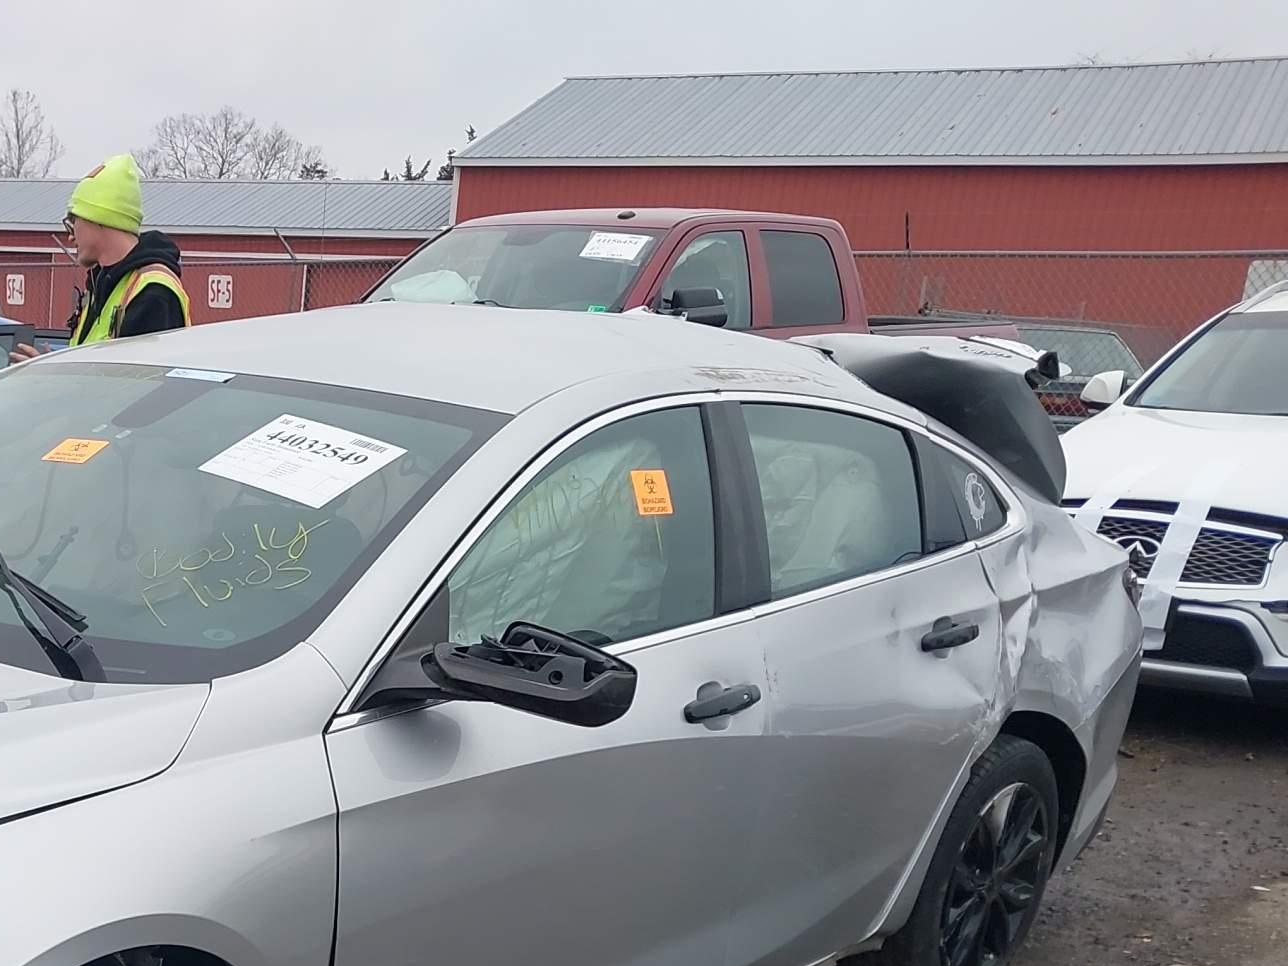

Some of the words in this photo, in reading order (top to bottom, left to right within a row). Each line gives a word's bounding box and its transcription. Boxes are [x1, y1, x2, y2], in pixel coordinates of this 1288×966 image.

[7, 278, 24, 301] SF-4
[210, 279, 231, 303] SF-5
[266, 429, 370, 466] 44032549
